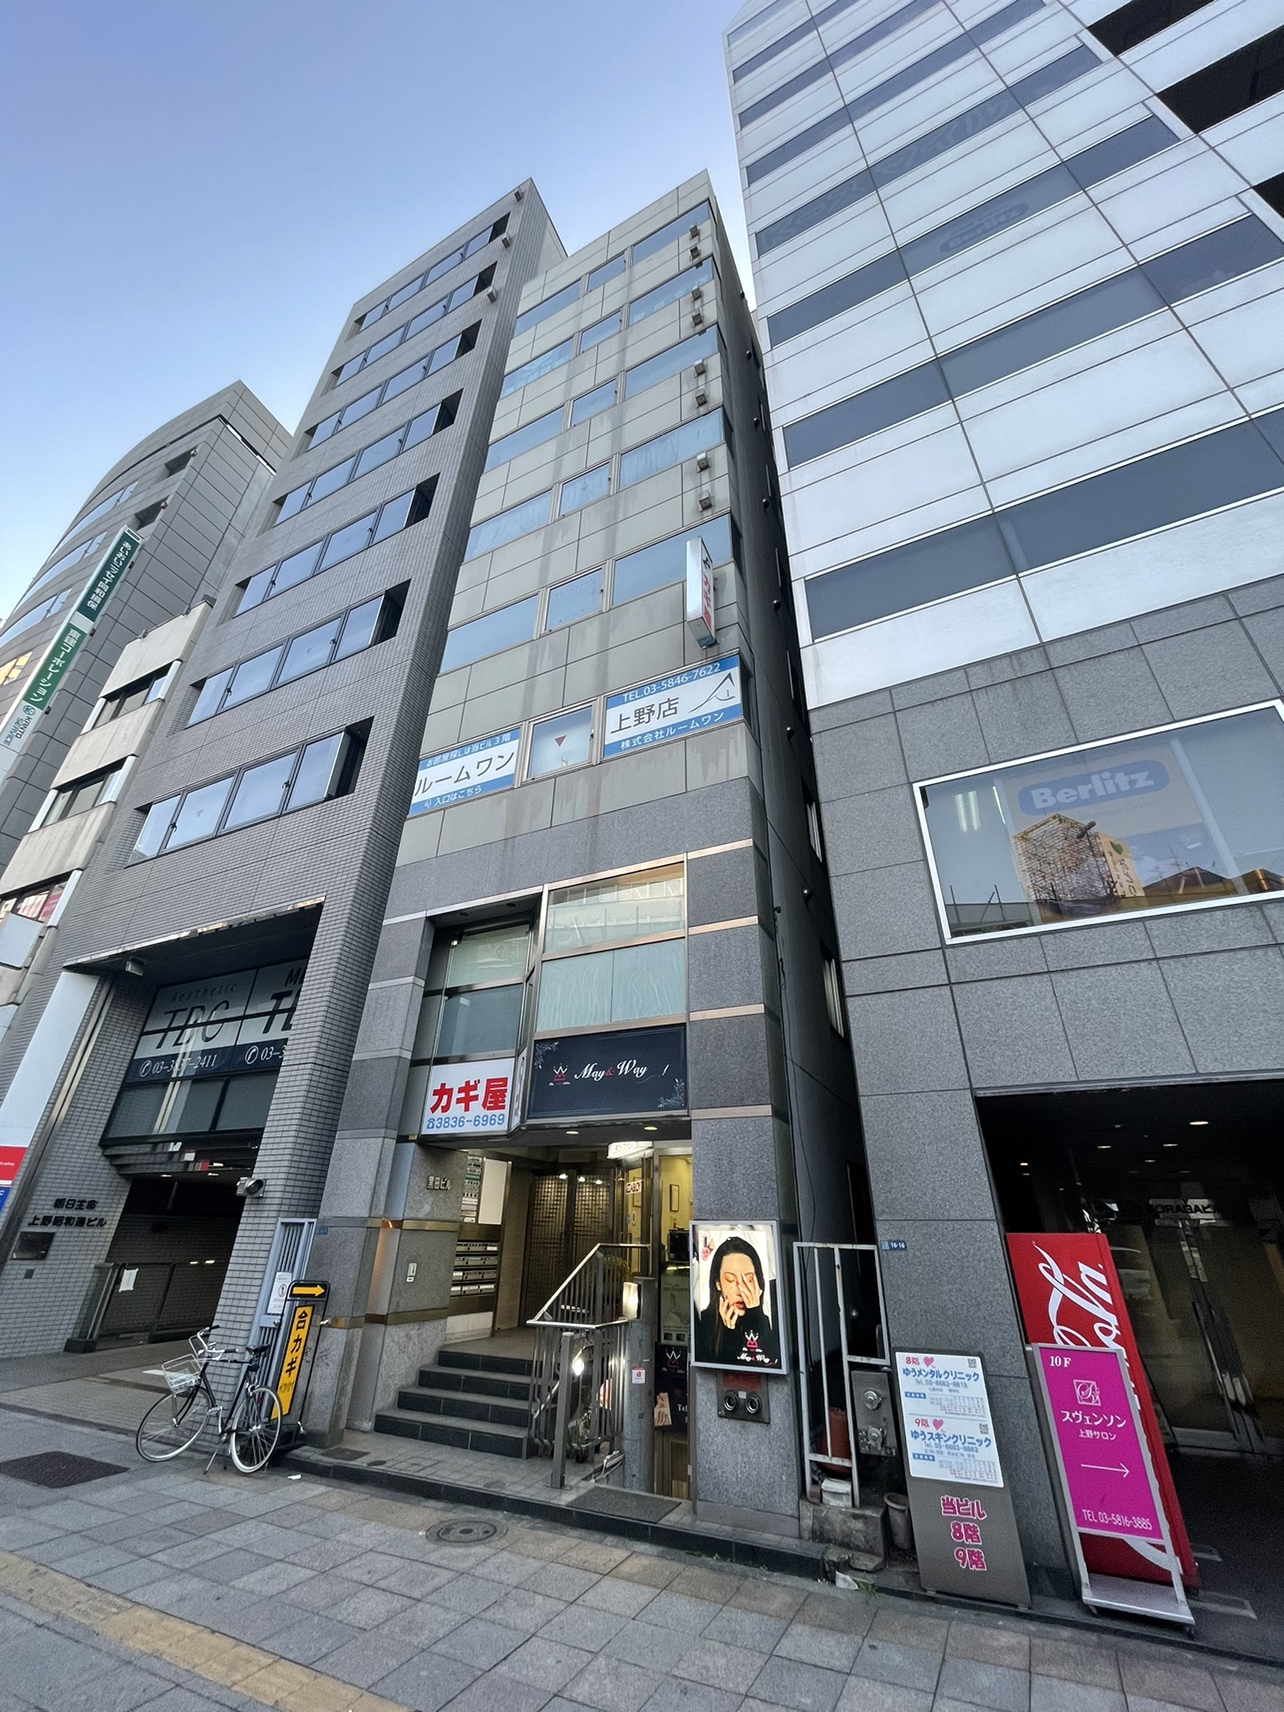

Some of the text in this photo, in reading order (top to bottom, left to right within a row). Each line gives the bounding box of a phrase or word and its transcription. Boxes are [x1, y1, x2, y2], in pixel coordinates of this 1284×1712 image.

[622, 662, 721, 703] TEL.03-5846-7622
[610, 697, 680, 734] 上野店
[620, 711, 724, 750] 株式会社ルームワン
[414, 752, 515, 797] ルームワン
[433, 785, 482, 806] 入口はこちら
[1030, 771, 1155, 810] Berlitz
[169, 982, 238, 1003] Aesthetic
[156, 1000, 230, 1050] TBC
[429, 1076, 509, 1115] カギ屋
[285, 1310, 308, 1378] 合カギ
[902, 1367, 980, 1382] ゆうメンタルクリニック
[1049, 1355, 1072, 1368] 10 F
[1060, 1409, 1127, 1428] スヴェンソン
[911, 1429, 992, 1448] ゆうスキンクリニック
[1078, 1429, 1117, 1441] 上野サロン
[941, 1494, 988, 1520] 当ビル
[1081, 1508, 1153, 1531] TEL 03-5816-3885
[951, 1520, 983, 1546] 8階
[954, 1546, 988, 1572] 9階
